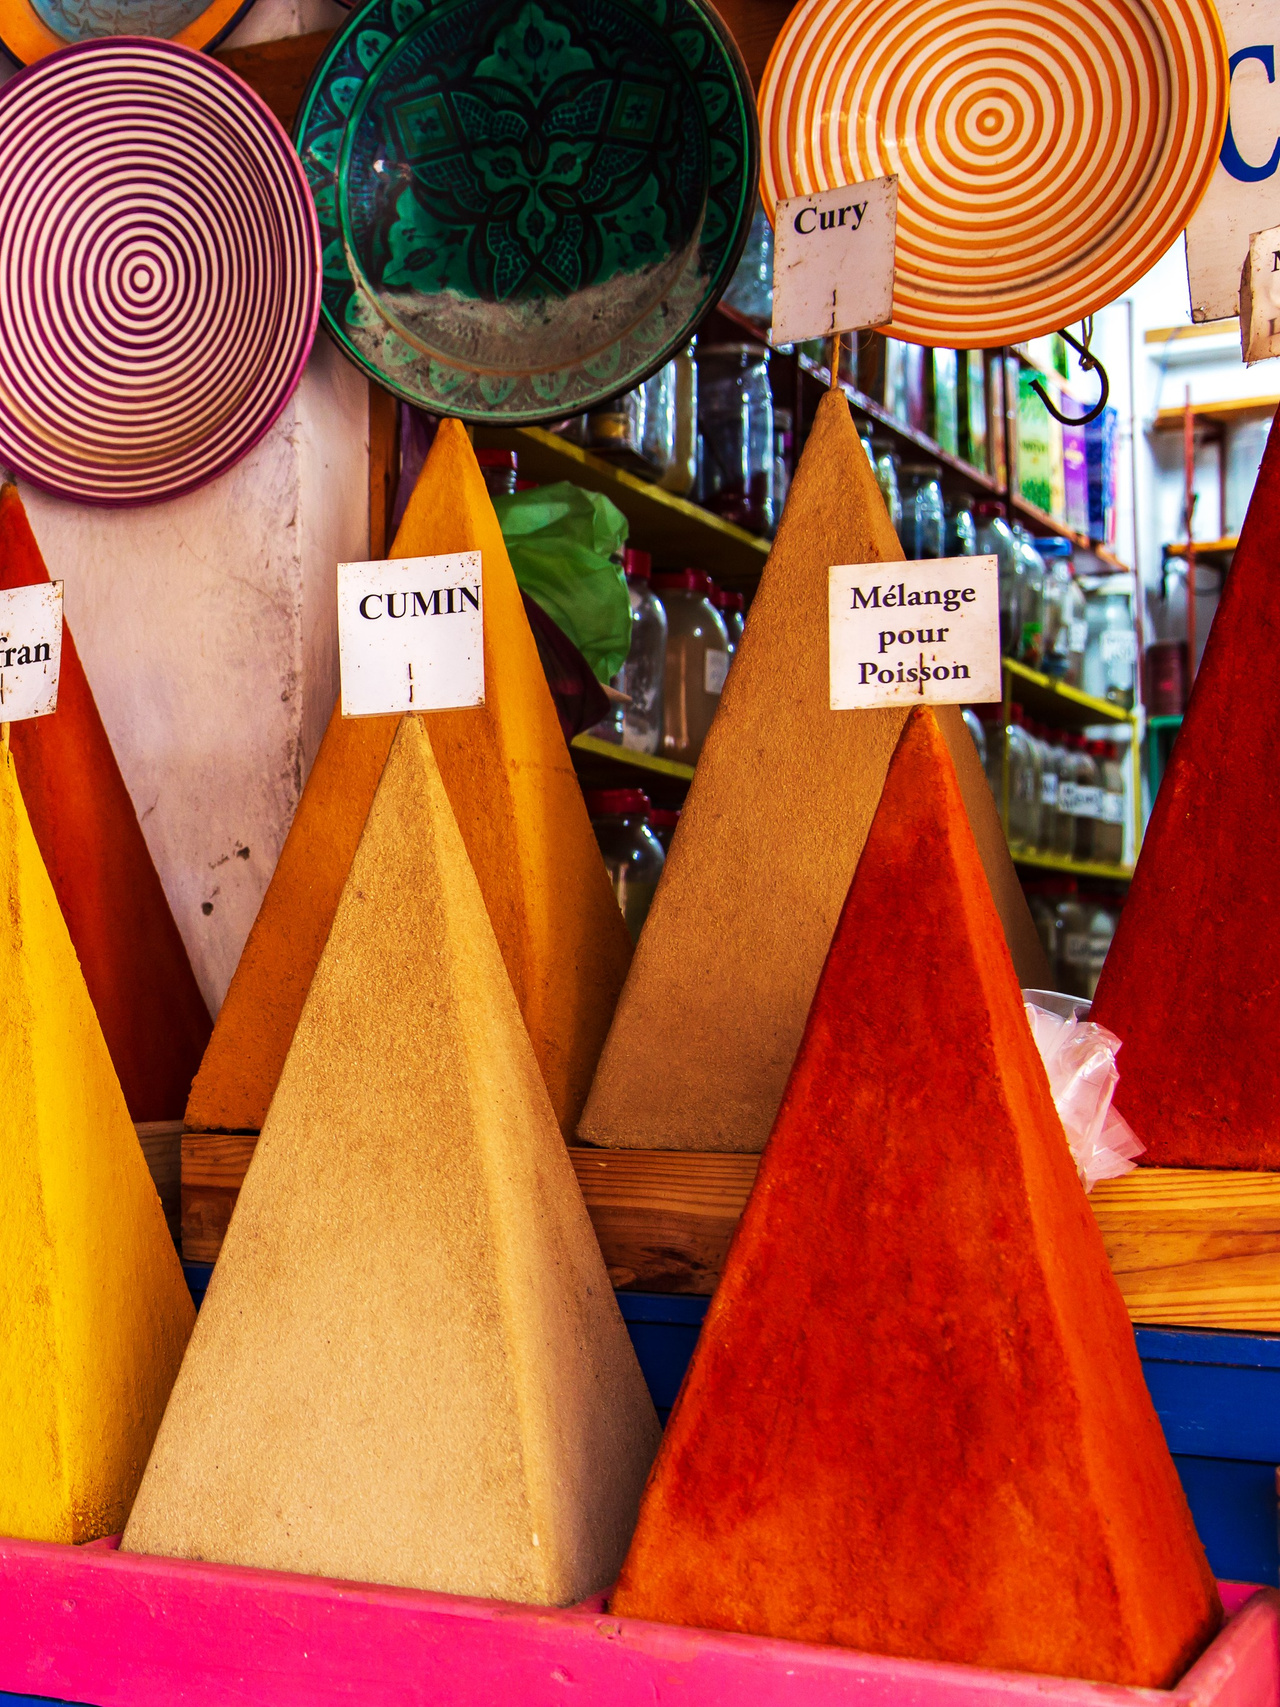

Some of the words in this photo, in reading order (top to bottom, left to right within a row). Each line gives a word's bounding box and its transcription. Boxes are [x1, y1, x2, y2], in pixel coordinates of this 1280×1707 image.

[794, 201, 868, 235] Cury
[359, 585, 481, 620] CUMIN
[850, 583, 976, 612] Mélange
[878, 627, 950, 654] pour
[858, 661, 972, 685] Poisson
